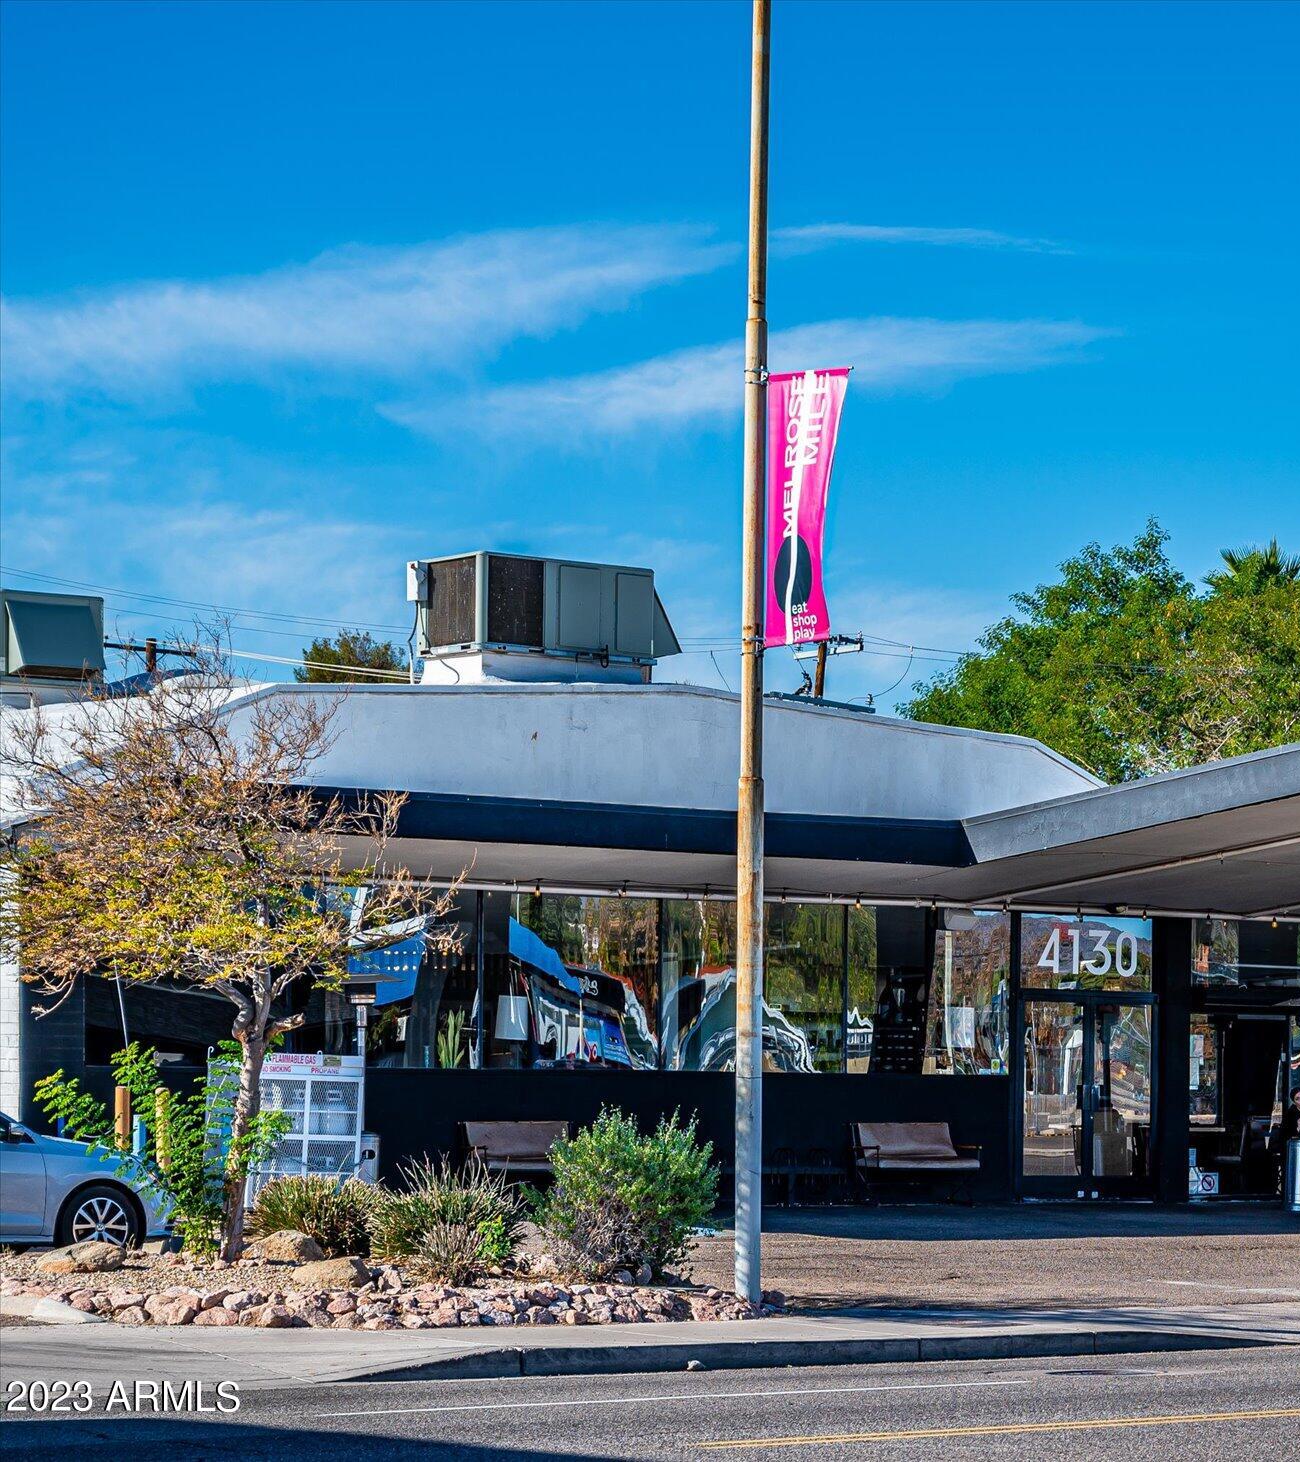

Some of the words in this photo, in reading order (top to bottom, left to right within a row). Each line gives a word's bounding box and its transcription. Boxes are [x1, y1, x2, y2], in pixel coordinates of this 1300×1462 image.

[802, 373, 830, 466] MILE
[782, 375, 804, 539] MELROSE
[791, 601, 809, 615] eat
[792, 613, 818, 628] shop
[794, 626, 816, 641] play
[1037, 928, 1138, 978] 4130
[272, 1054, 304, 1065] FLAMMABLE
[305, 1055, 317, 1065] GAS
[269, 1065, 292, 1073] SMOKING
[310, 1067, 340, 1075] PROPANE
